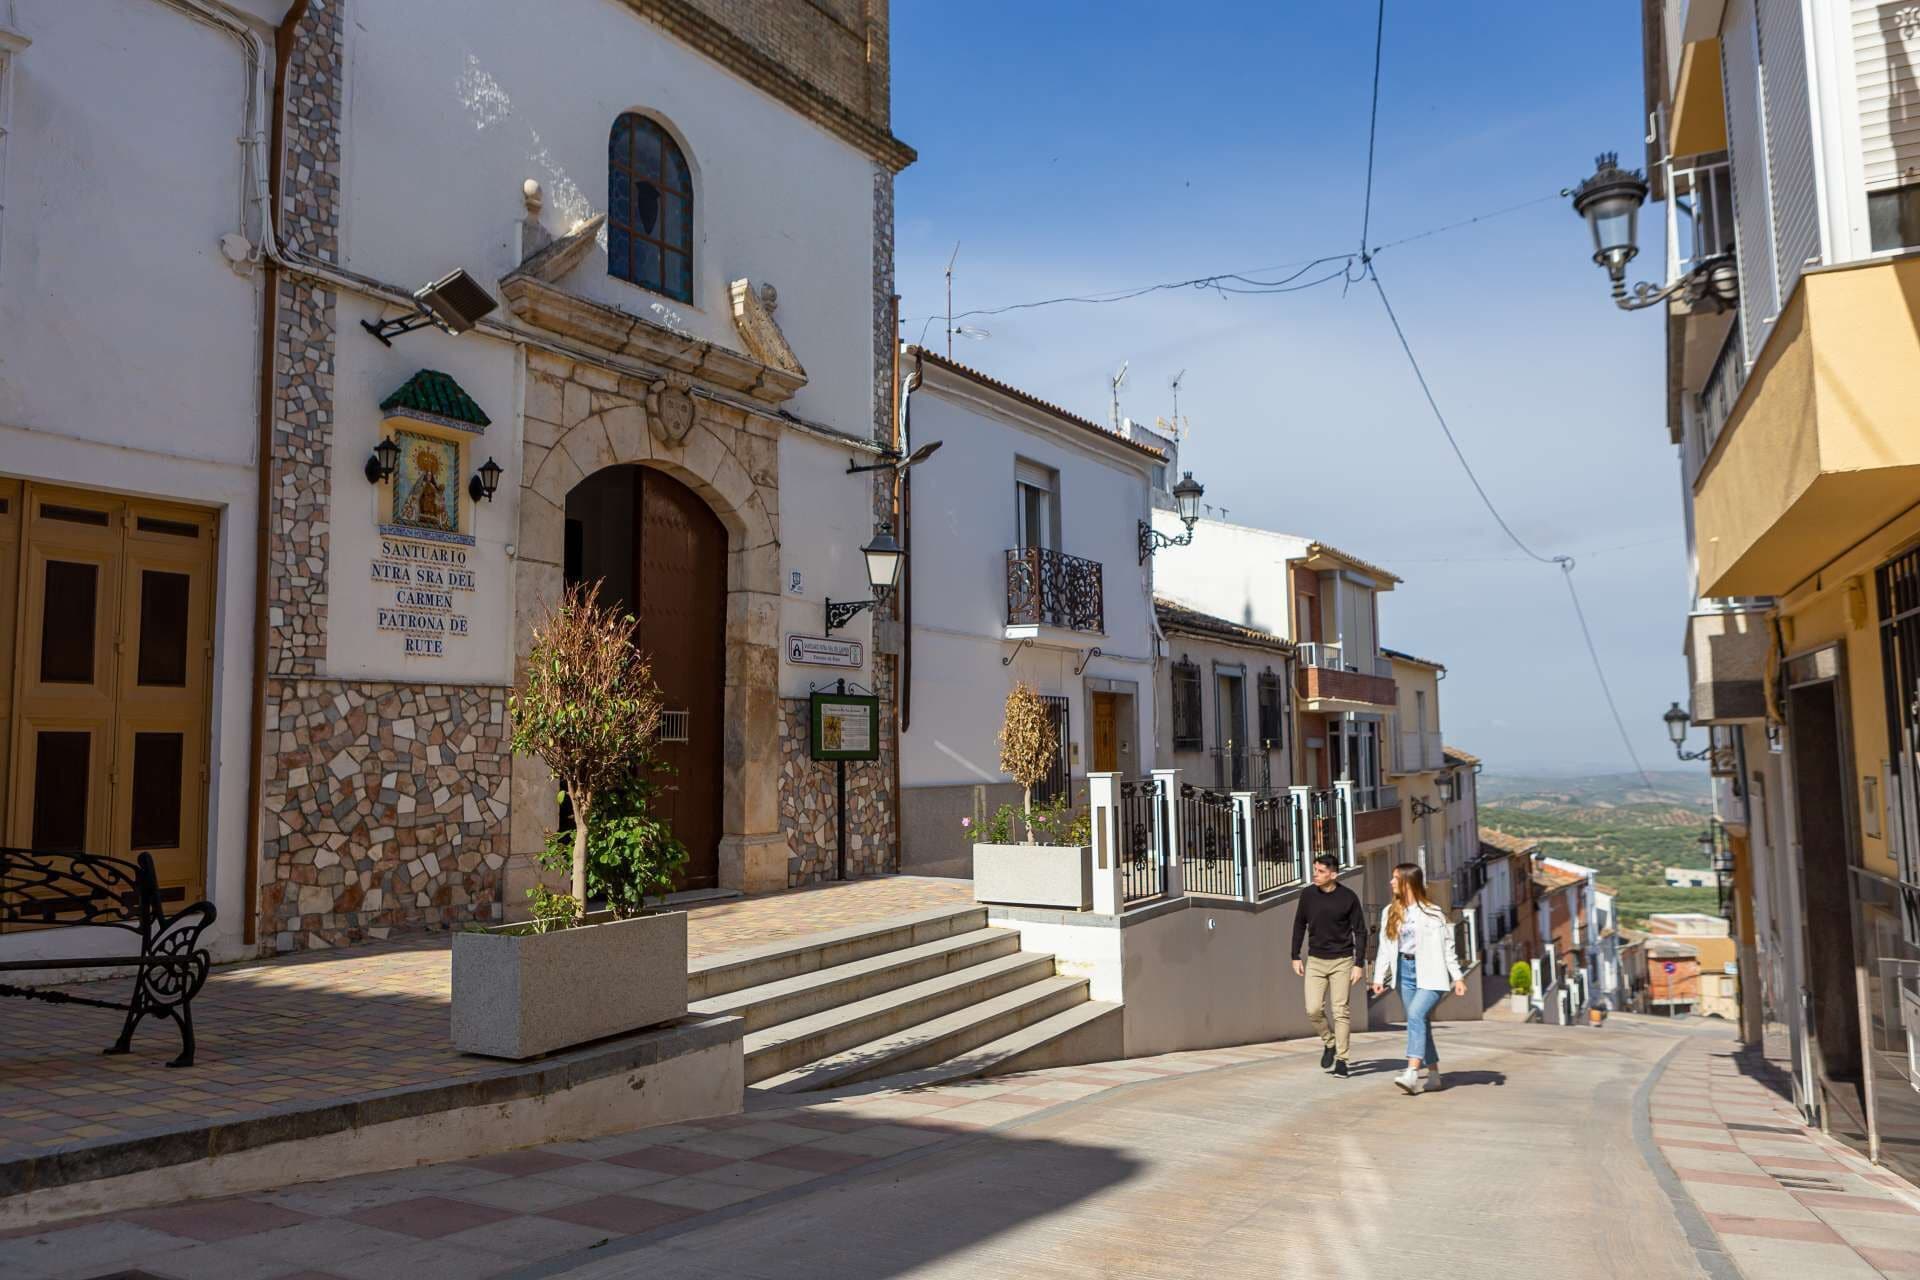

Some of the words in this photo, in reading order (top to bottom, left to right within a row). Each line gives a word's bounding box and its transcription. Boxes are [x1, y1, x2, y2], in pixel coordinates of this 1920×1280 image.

[382, 541, 466, 563] SANTUARIO
[371, 563, 410, 580] NTRA
[416, 569, 444, 585] SRA
[448, 572, 475, 588] DEL
[396, 590, 453, 608] CARMEN
[379, 612, 445, 630] PATRONA
[450, 618, 468, 632] DE
[405, 638, 442, 653] RUTE
